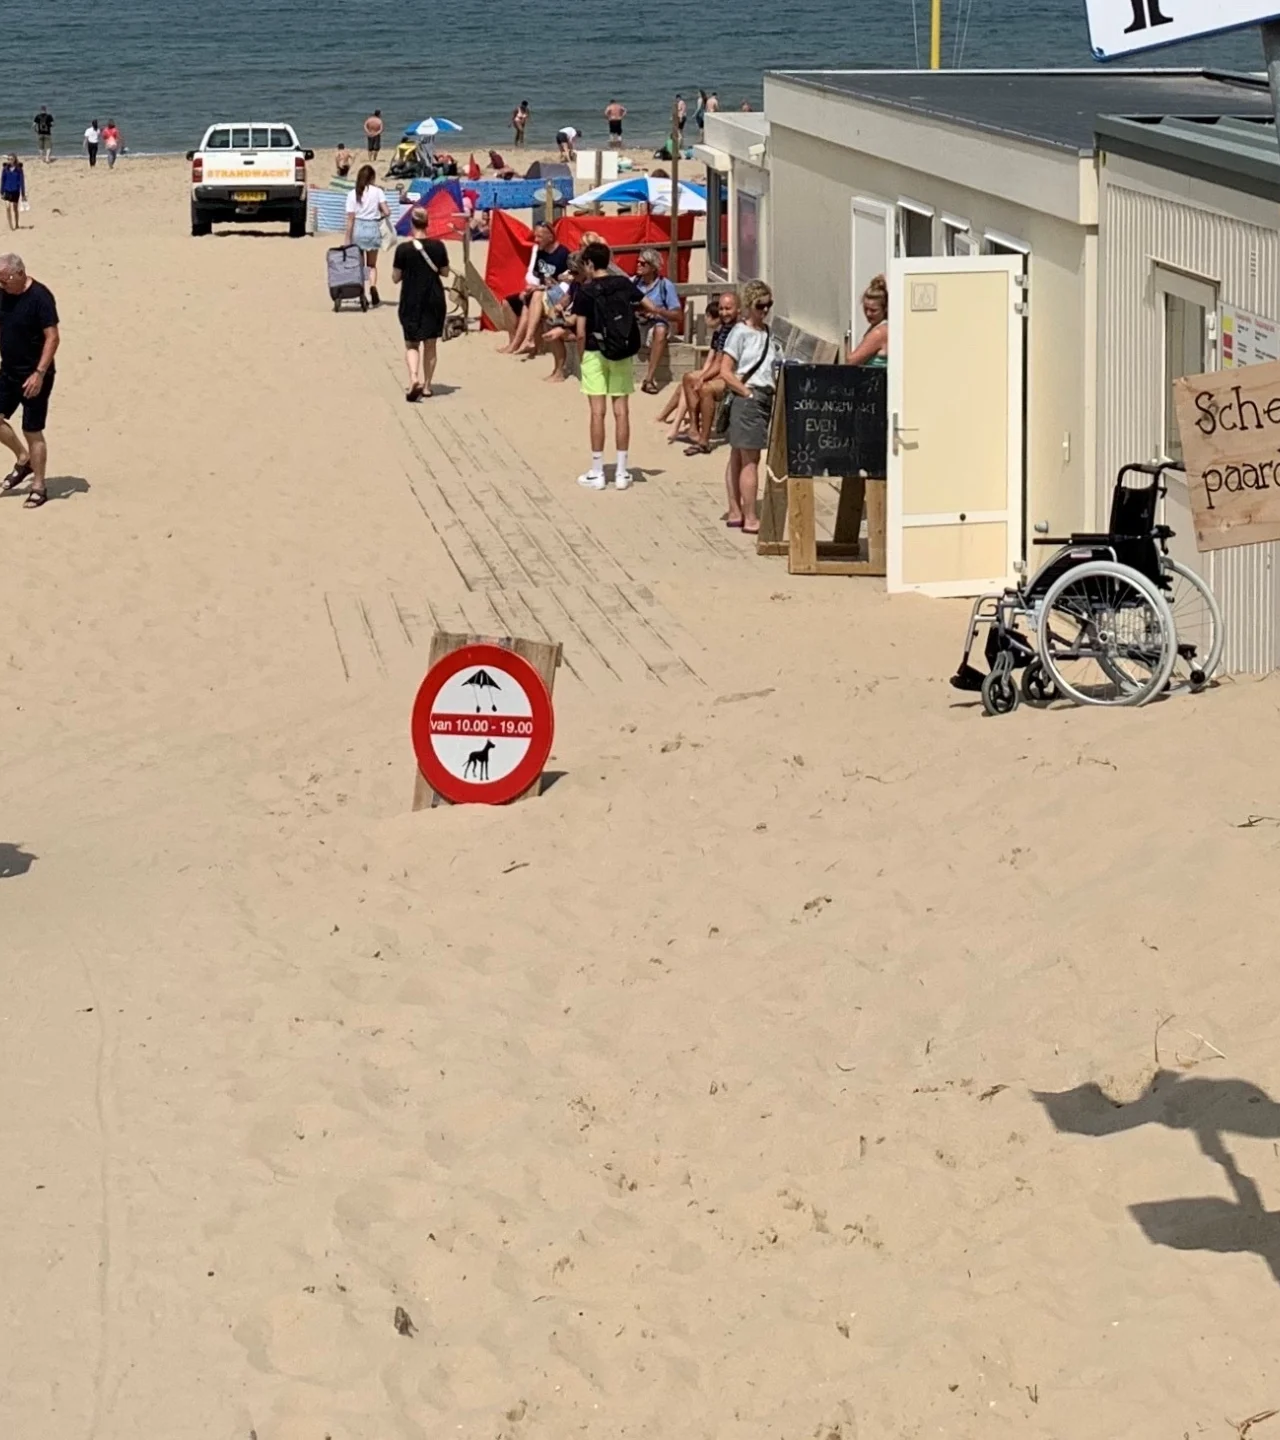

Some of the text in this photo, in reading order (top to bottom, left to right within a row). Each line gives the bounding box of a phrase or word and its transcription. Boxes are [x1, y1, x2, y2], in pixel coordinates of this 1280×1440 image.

[206, 168, 292, 178] STRANDWACHT
[431, 720, 452, 731] van
[456, 719, 488, 732] 10.00
[500, 720, 534, 734] 19.00
